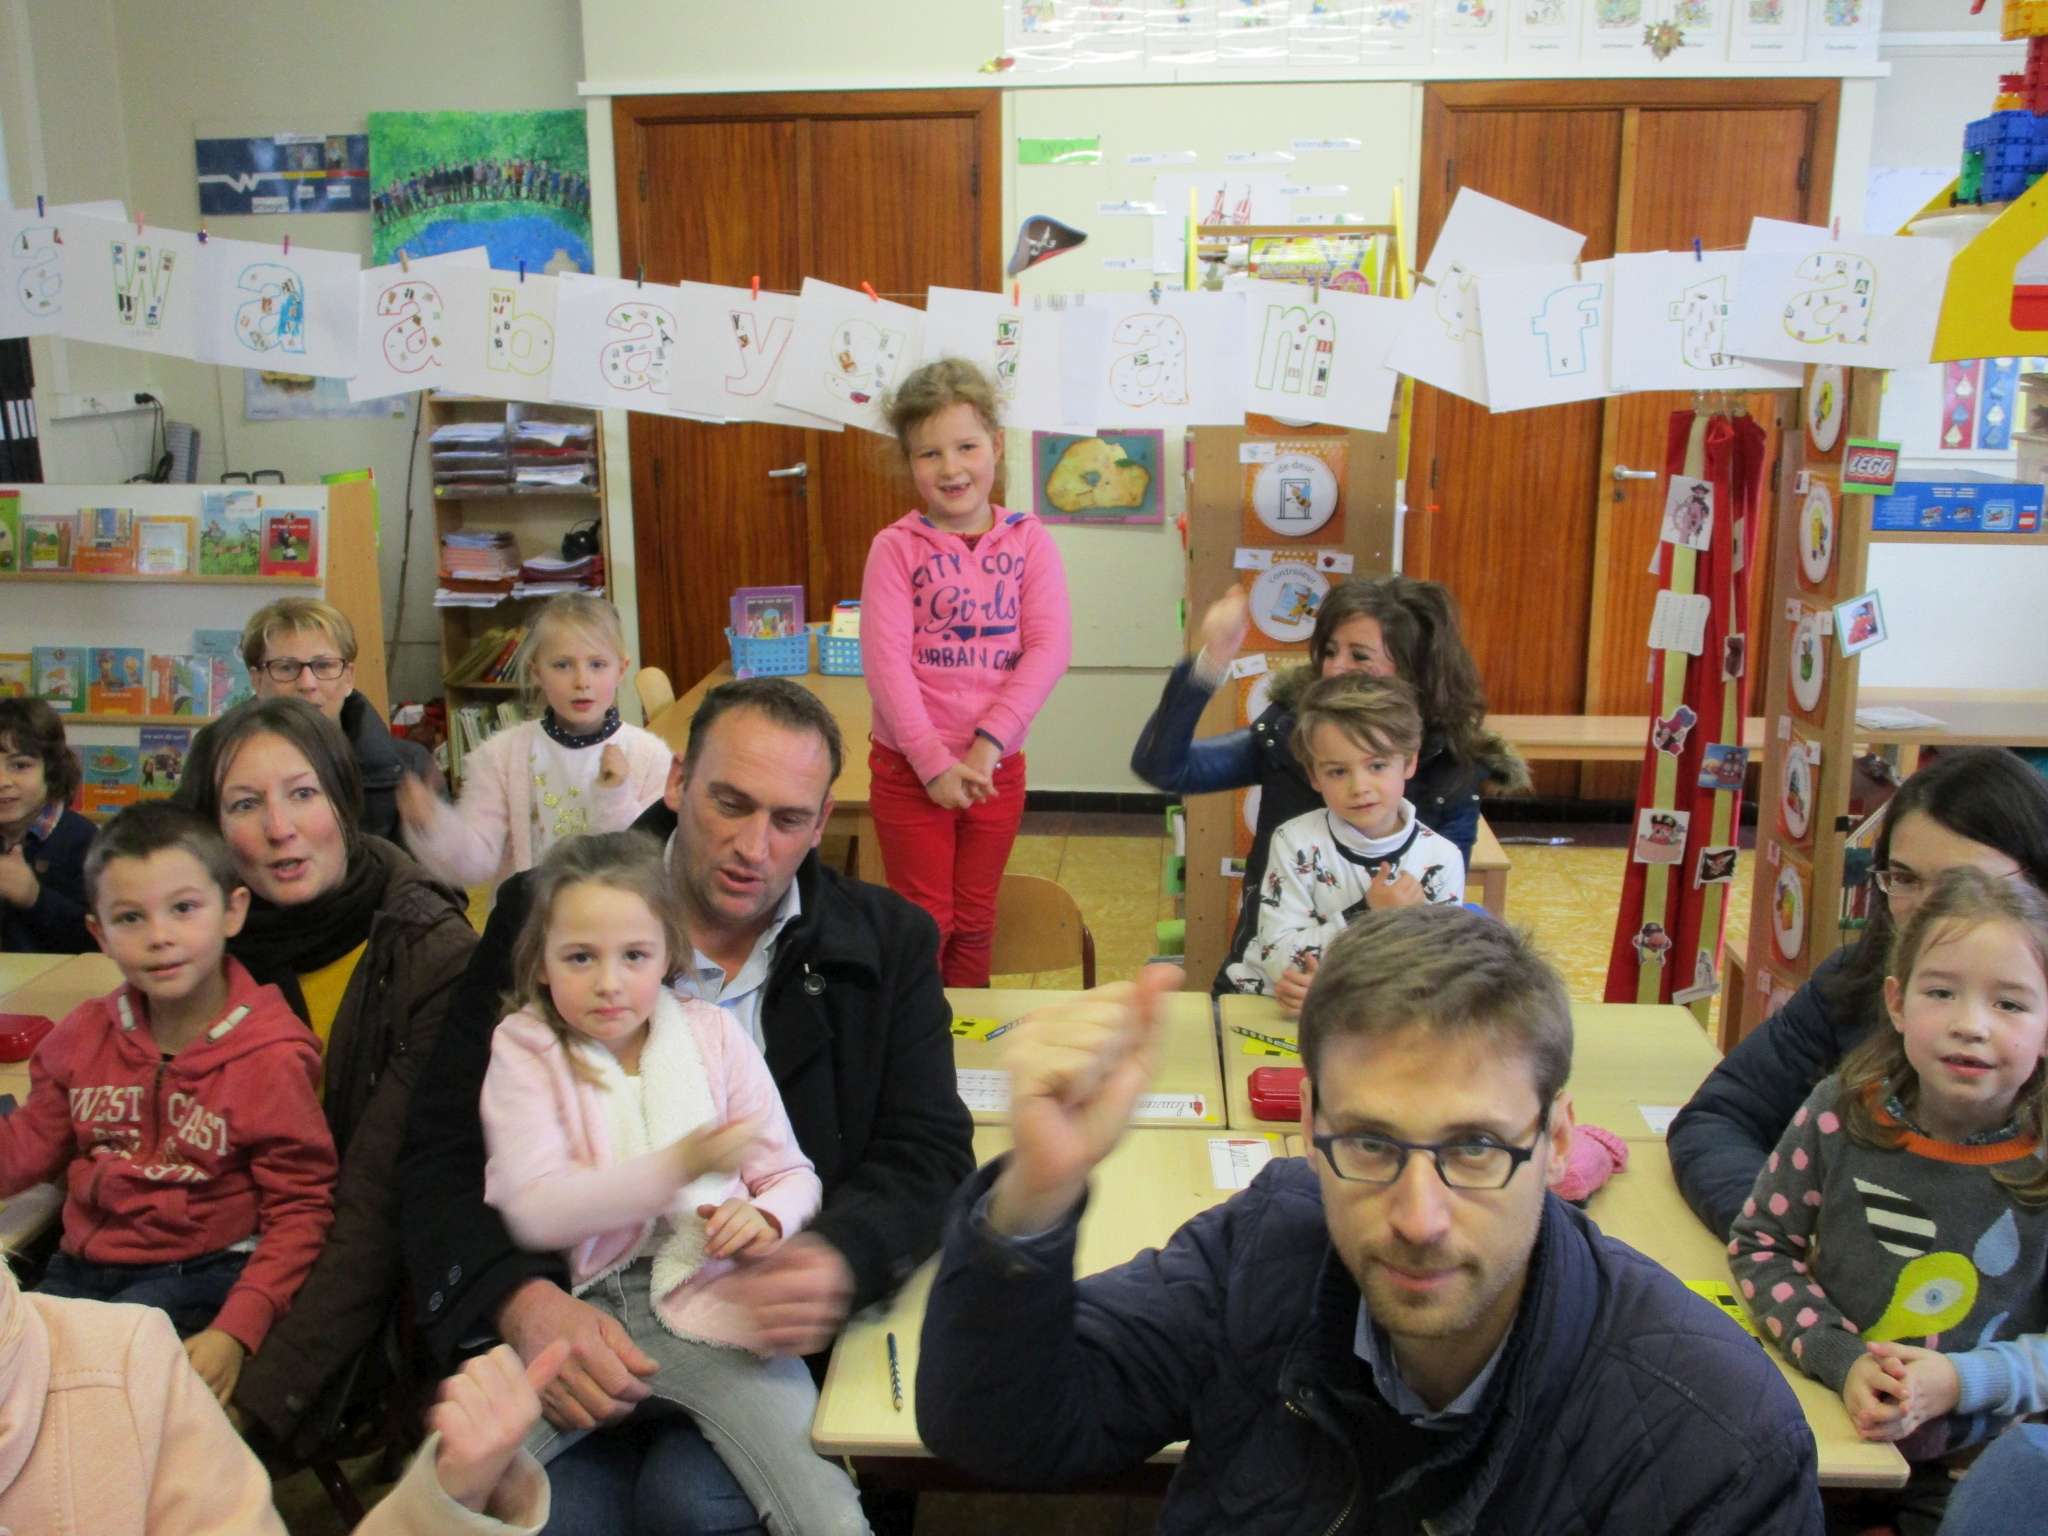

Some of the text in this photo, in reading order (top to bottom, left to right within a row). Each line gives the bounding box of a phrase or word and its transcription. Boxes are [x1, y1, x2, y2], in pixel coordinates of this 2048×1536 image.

[234, 262, 307, 355] a
[487, 287, 555, 377] b
[1531, 282, 1603, 378] f
[1783, 251, 1878, 345] a
[600, 301, 677, 396] a
[725, 310, 795, 397] y
[1109, 312, 1190, 409] a
[1255, 304, 1337, 398] m
[1848, 455, 1891, 476] LEGO
[912, 554, 961, 588] CITY
[924, 580, 1017, 634] Girls
[918, 647, 987, 668] URBAN
[69, 1085, 144, 1123] WEST
